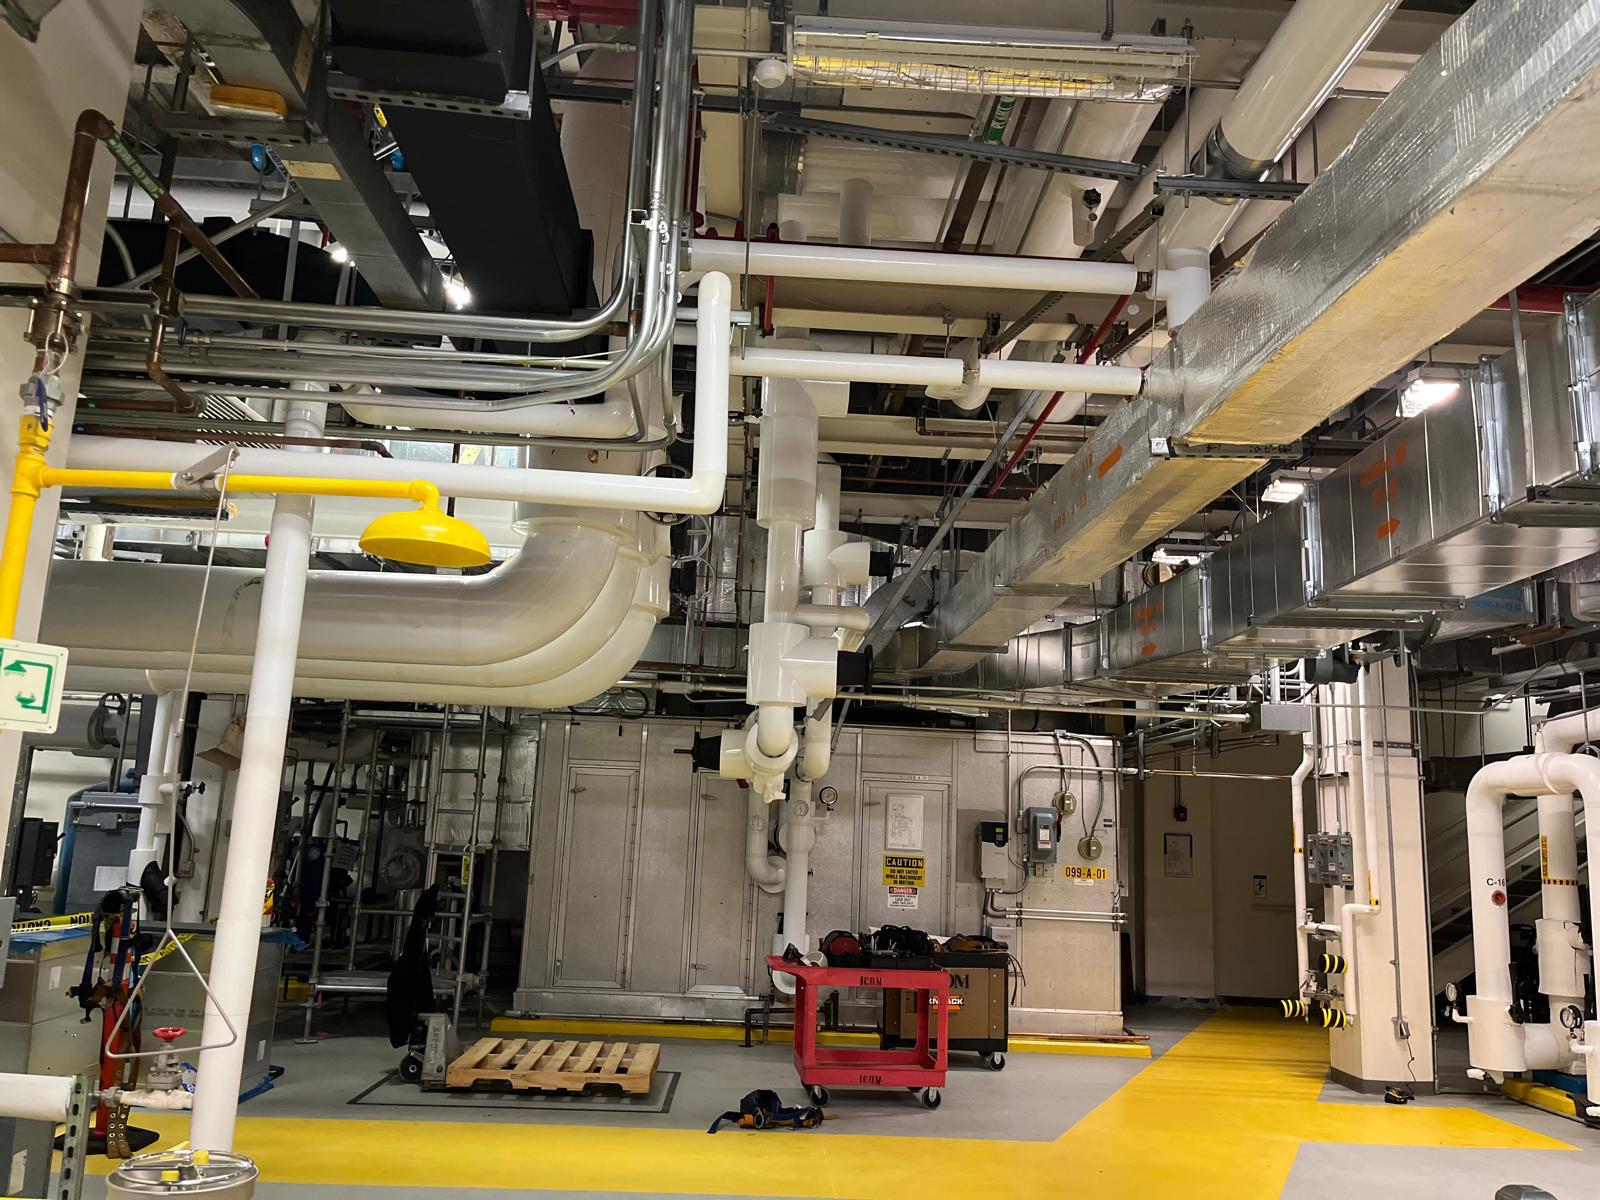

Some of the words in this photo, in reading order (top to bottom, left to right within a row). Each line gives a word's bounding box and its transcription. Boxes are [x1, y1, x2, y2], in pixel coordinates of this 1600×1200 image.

[886, 858, 923, 868] CAUTION
[1065, 866, 1106, 879] 099-A-01
[1486, 877, 1506, 887] C-16
[860, 976, 882, 986] ICOM
[859, 1074, 882, 1085] ICOM
